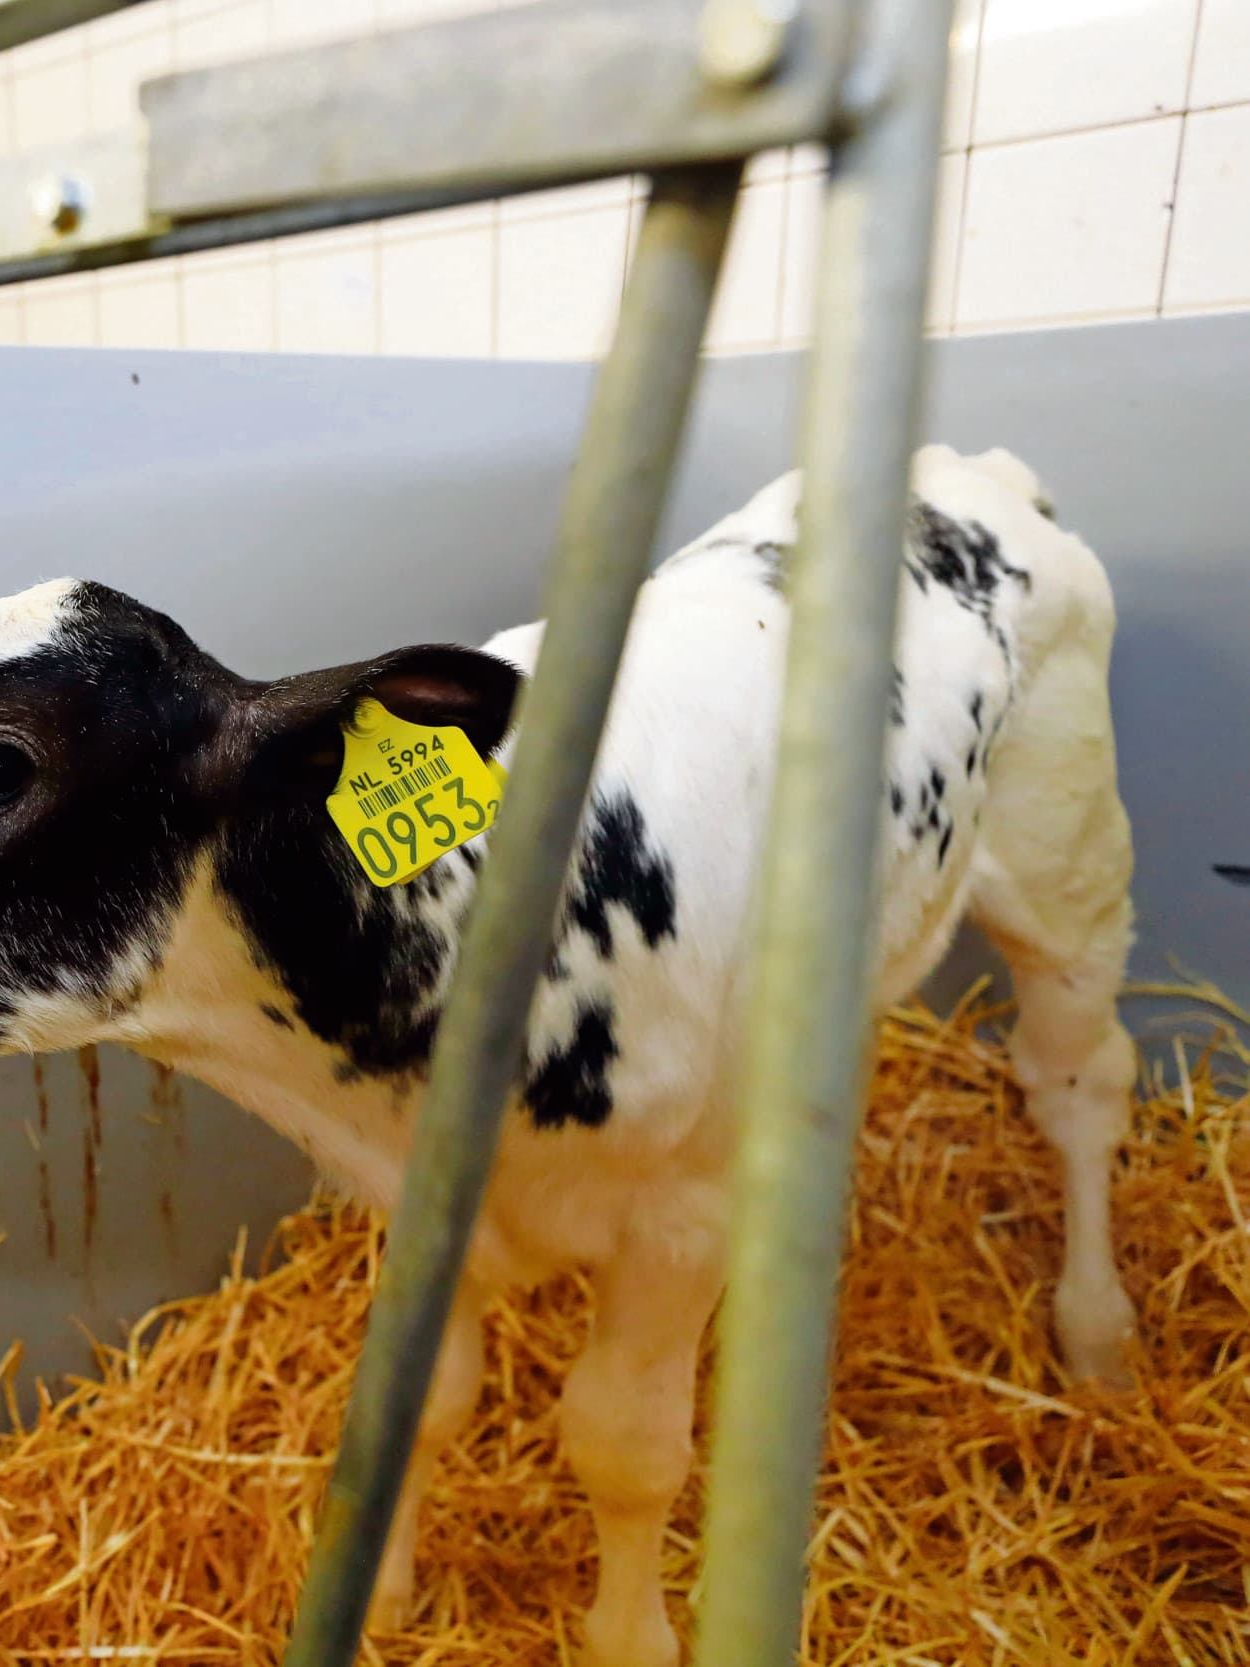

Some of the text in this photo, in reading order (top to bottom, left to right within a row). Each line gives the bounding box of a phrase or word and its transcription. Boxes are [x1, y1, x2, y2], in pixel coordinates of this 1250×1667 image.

[349, 735, 444, 795] NL 5994
[378, 738, 395, 753] EZ
[357, 777, 486, 878] 0953
